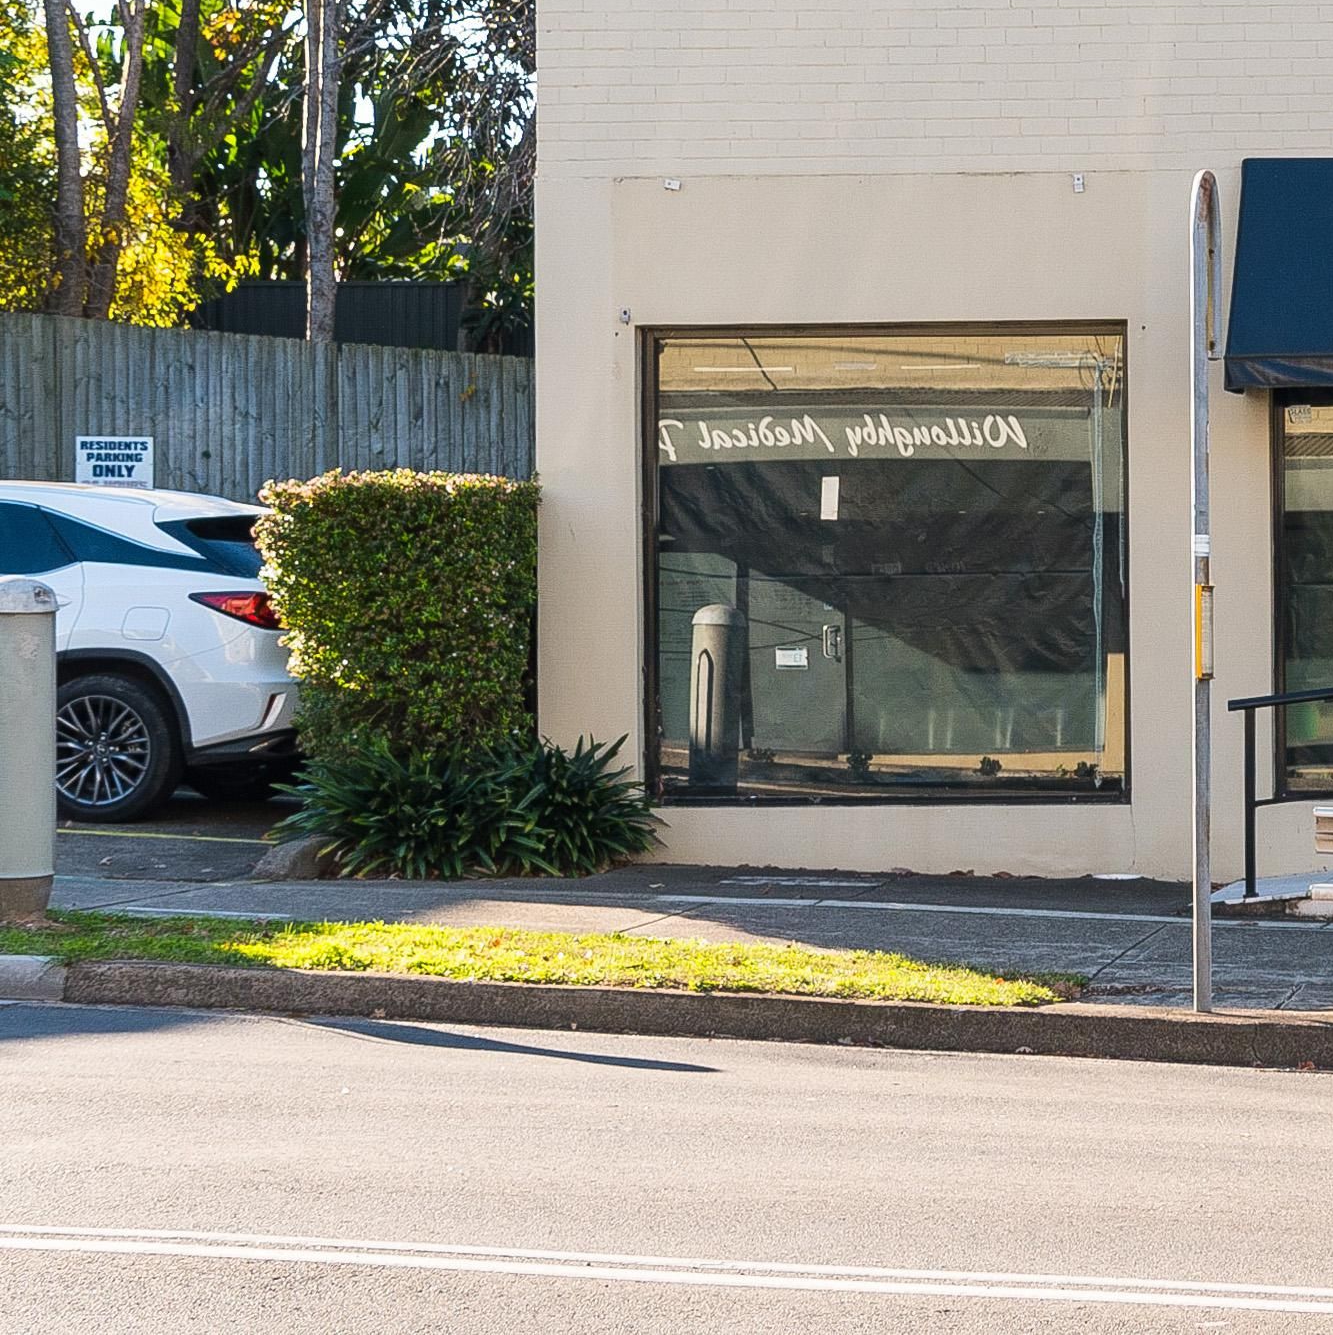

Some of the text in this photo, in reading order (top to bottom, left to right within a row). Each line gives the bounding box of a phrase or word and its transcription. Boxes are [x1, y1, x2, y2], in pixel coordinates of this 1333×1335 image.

[80, 440, 149, 451] RESIDENTS
[86, 452, 144, 463] PARKING
[92, 464, 136, 478] ONLY
